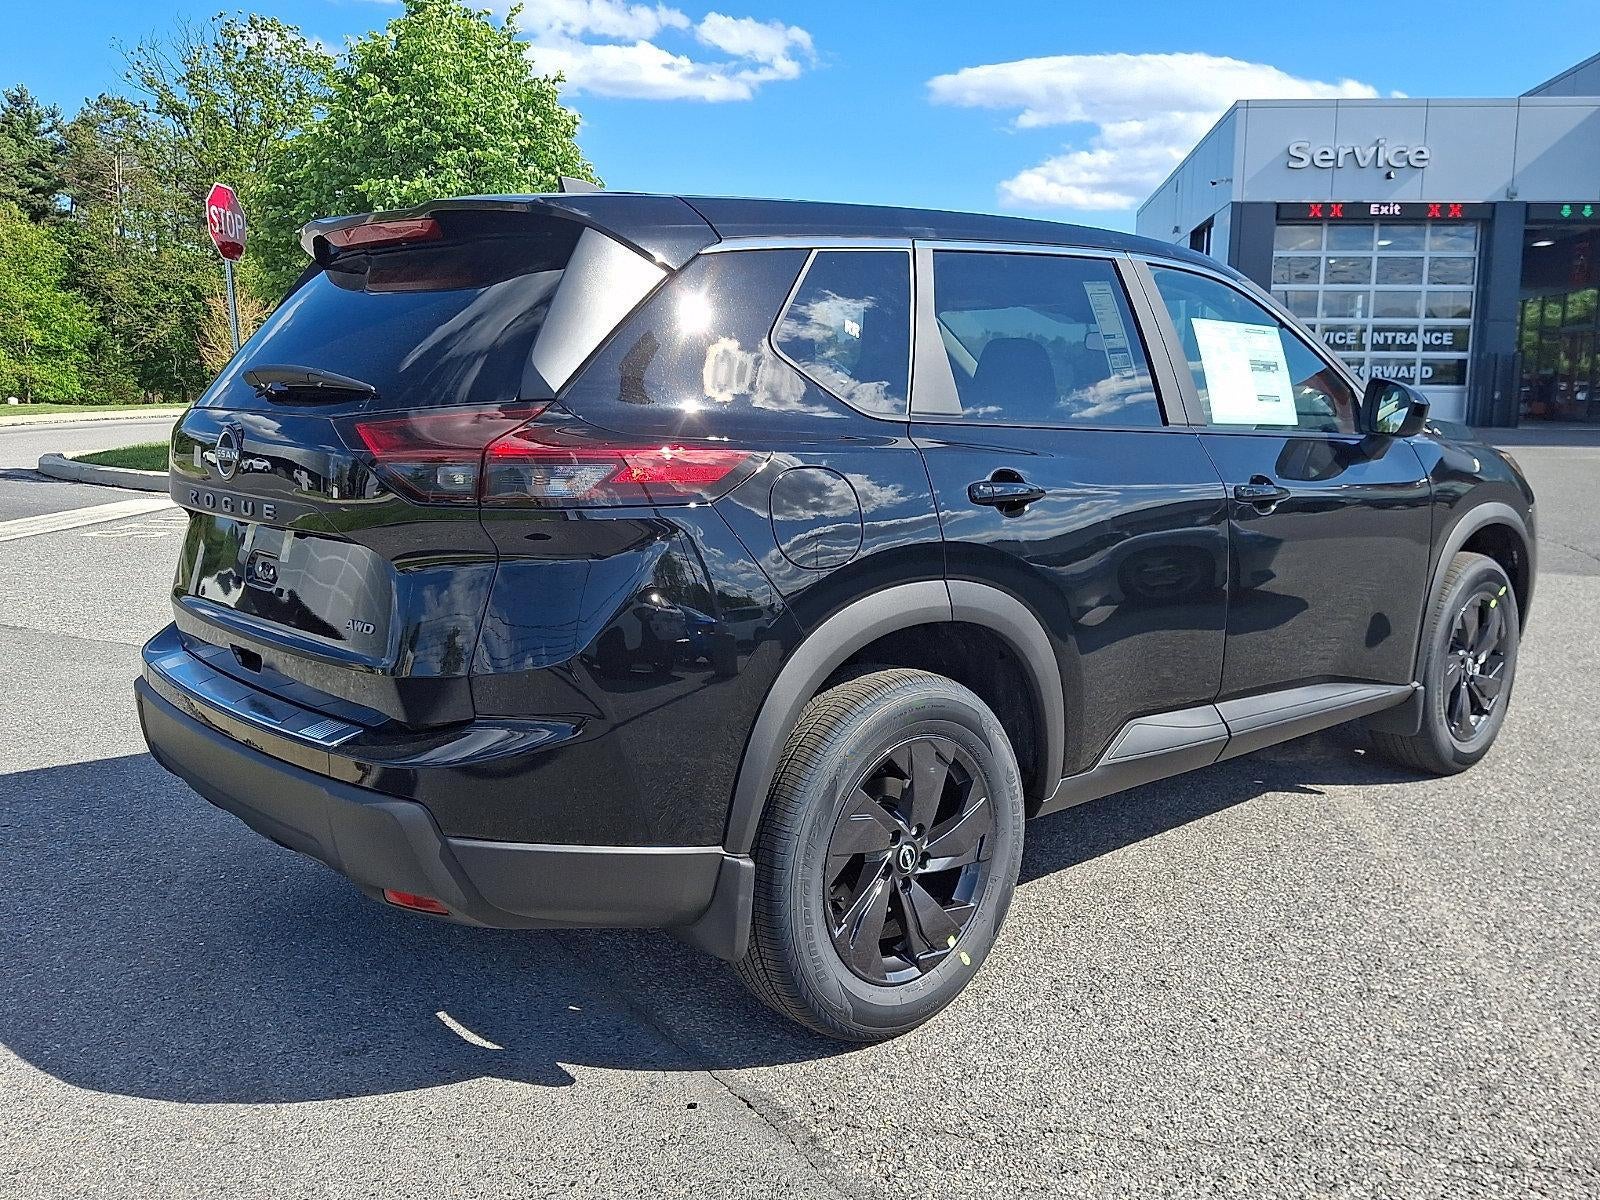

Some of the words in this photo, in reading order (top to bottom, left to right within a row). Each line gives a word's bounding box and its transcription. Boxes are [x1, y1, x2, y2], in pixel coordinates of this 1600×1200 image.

[1287, 138, 1431, 169] Service
[1369, 203, 1402, 216] Exit
[209, 204, 243, 240] STOP
[1319, 331, 1357, 344] VICE
[189, 489, 279, 520] ROGUE
[345, 619, 376, 634] AWD
